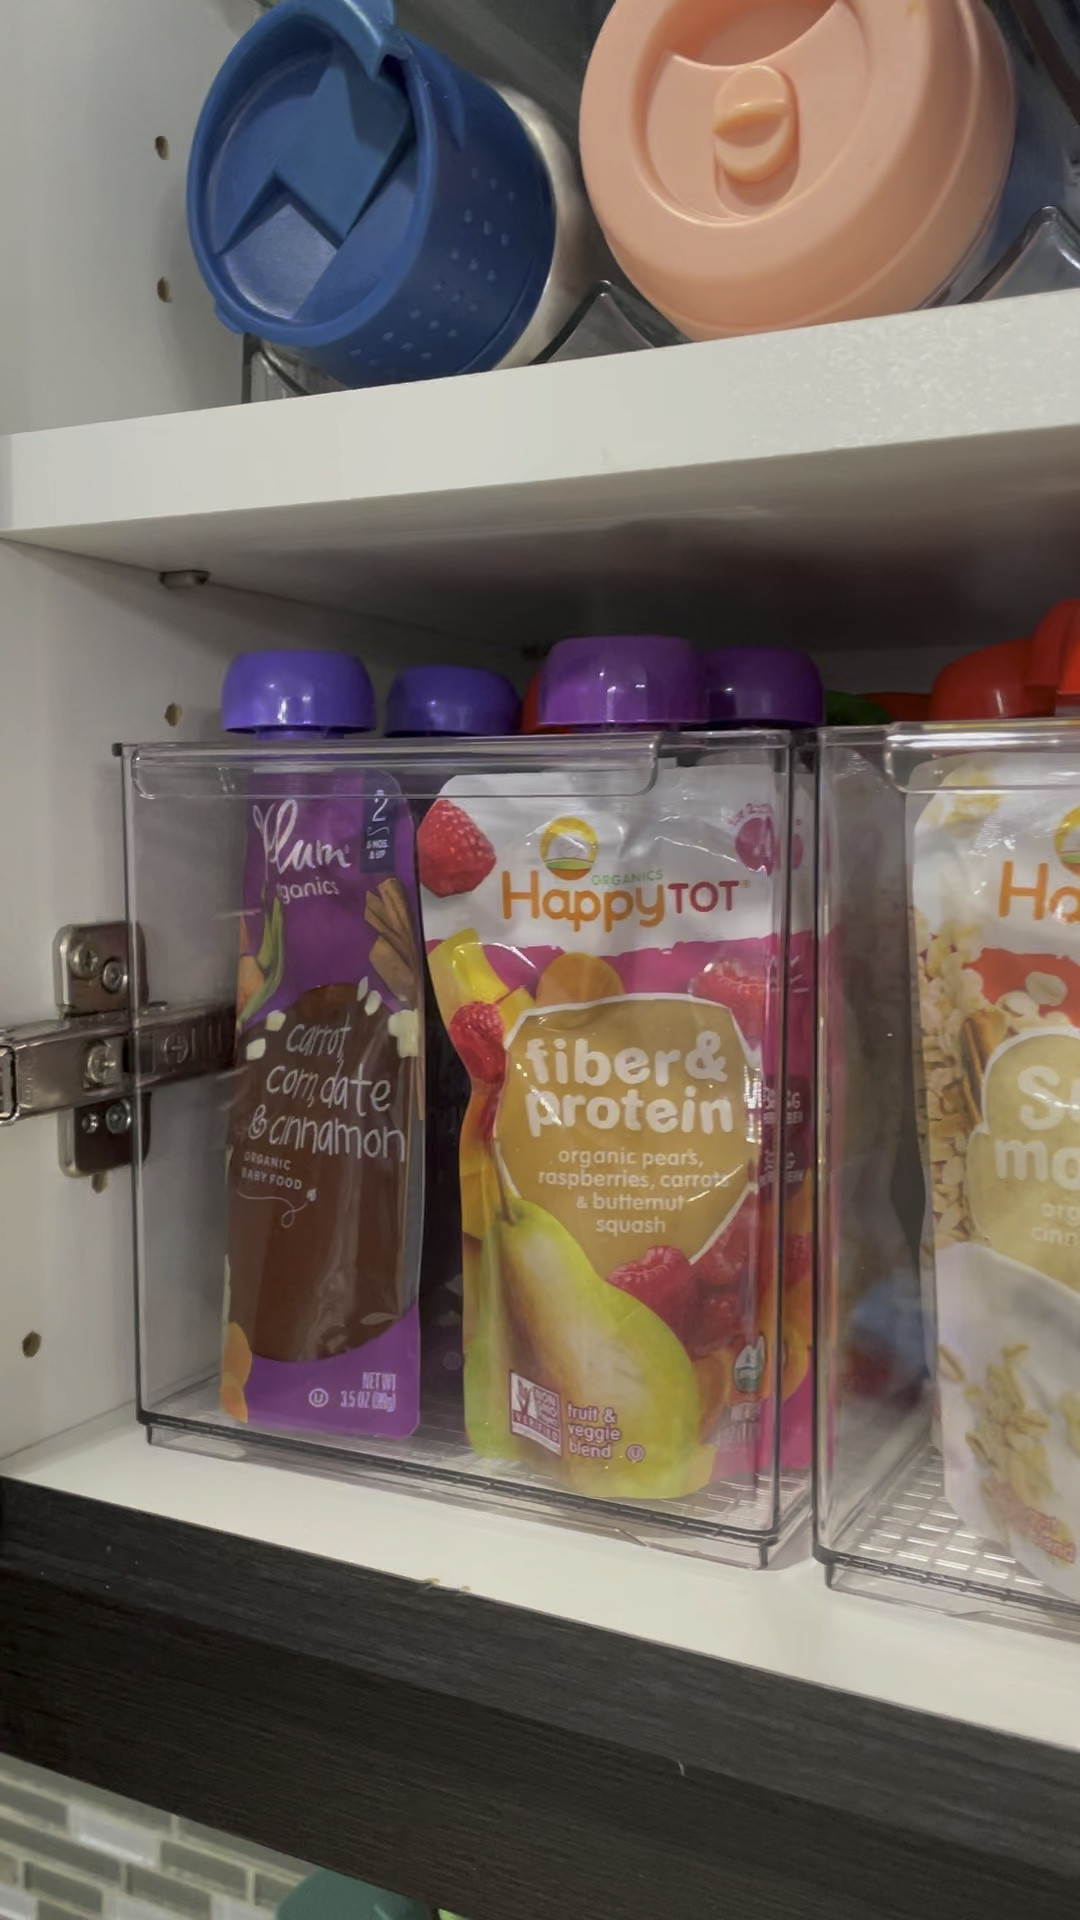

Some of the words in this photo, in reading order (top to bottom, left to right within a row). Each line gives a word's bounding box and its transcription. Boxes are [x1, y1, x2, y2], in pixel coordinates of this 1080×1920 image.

[372, 789, 388, 822] 2
[253, 798, 351, 880] Plum
[592, 869, 663, 886] ORGANICS
[525, 1038, 681, 1086] fiber
[685, 1030, 728, 1083] &
[320, 1062, 391, 1117] date
[1018, 1065, 1080, 1130] S
[525, 1086, 734, 1137] protein
[269, 1115, 406, 1162] cinnamon
[243, 1151, 291, 1170] ORGANIC
[558, 1150, 636, 1168] organic
[642, 1150, 704, 1170] pears,
[241, 1167, 270, 1182] BABY
[269, 1173, 302, 1190] FOOD
[538, 1168, 655, 1190] raspberries,
[659, 1171, 730, 1188] carrots
[576, 1197, 588, 1208] &
[593, 1193, 684, 1211] butternut
[595, 1217, 666, 1234] squash
[362, 1372, 379, 1389] NET
[381, 1373, 396, 1391] WT
[567, 1403, 598, 1421] fruit
[604, 1406, 617, 1423] &
[567, 1423, 621, 1442] veggie
[568, 1439, 612, 1458] blend
